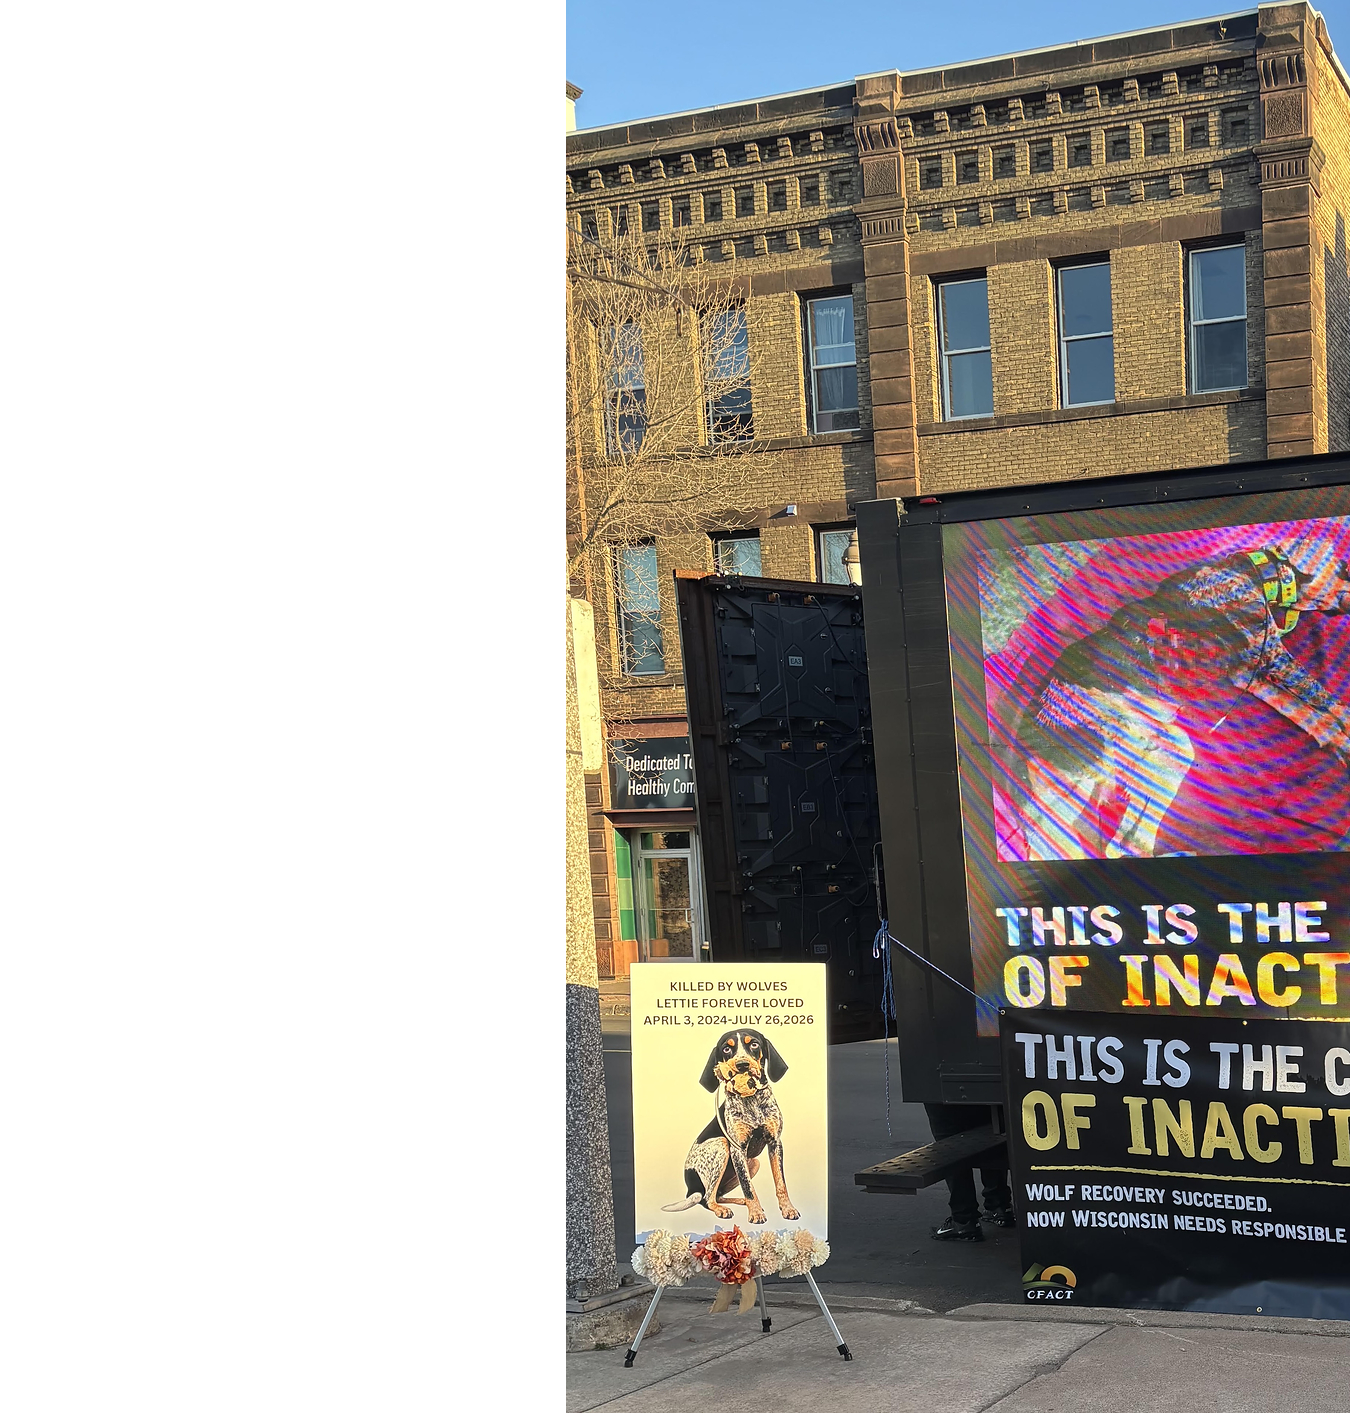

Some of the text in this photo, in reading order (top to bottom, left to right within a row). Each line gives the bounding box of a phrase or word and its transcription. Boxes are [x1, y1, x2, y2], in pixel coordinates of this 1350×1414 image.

[626, 753, 680, 772] Dedicated
[628, 778, 671, 798] Healthy
[996, 905, 1124, 947] THIS
[1141, 903, 1199, 946] IS
[1217, 901, 1331, 944] THE
[670, 981, 788, 992] KILLED BY WOLVES
[1003, 954, 1090, 1008] OF
[656, 998, 804, 1009] LETTIE FOREVER LOVED
[643, 1014, 814, 1028] APRIL 3, 2024-JULY 26,2026
[1015, 1033, 1125, 1084] THIS
[1142, 1038, 1191, 1088] IS
[1209, 1042, 1307, 1094] THE
[1021, 1090, 1097, 1151] OF
[1025, 1183, 1273, 1213] WOLF RECOVERY SUCCEEDED.
[1026, 1211, 1065, 1228] NOW
[1071, 1209, 1169, 1230] WISCONSIN
[1173, 1214, 1227, 1234] NEEDS
[1231, 1219, 1348, 1244] RESPONSIBLE
[1026, 1289, 1075, 1300] CFACT
